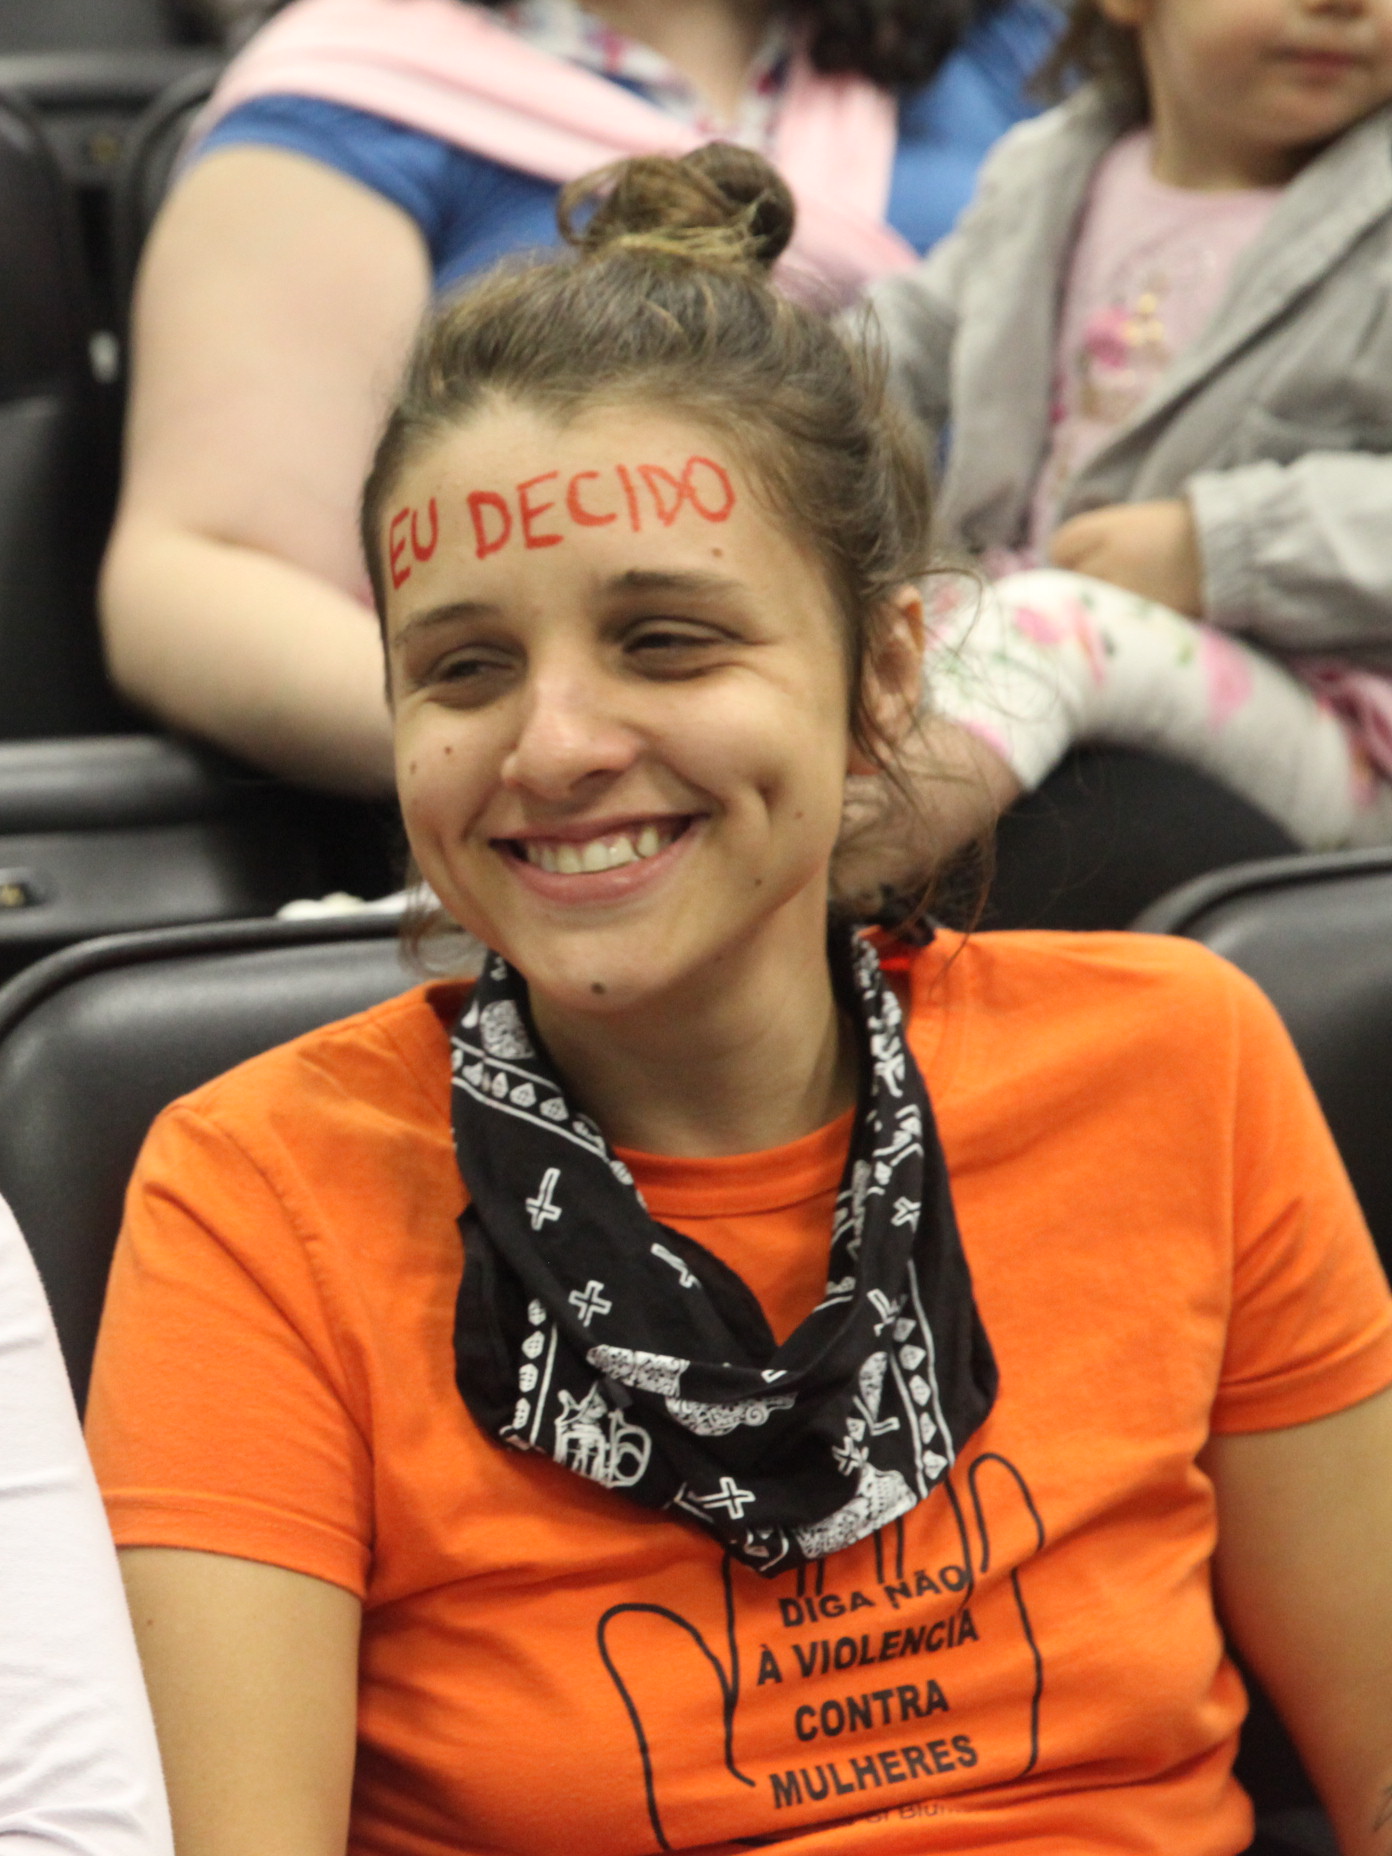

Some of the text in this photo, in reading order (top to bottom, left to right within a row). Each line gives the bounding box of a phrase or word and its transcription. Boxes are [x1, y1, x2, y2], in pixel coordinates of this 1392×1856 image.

[388, 455, 736, 590] EU DECIDO
[778, 1564, 968, 1628] DIGA NÃO
[756, 1608, 979, 1686] À VIOLENCIA
[795, 1679, 949, 1742] CONTRA
[769, 1734, 978, 1809] MULHERES
